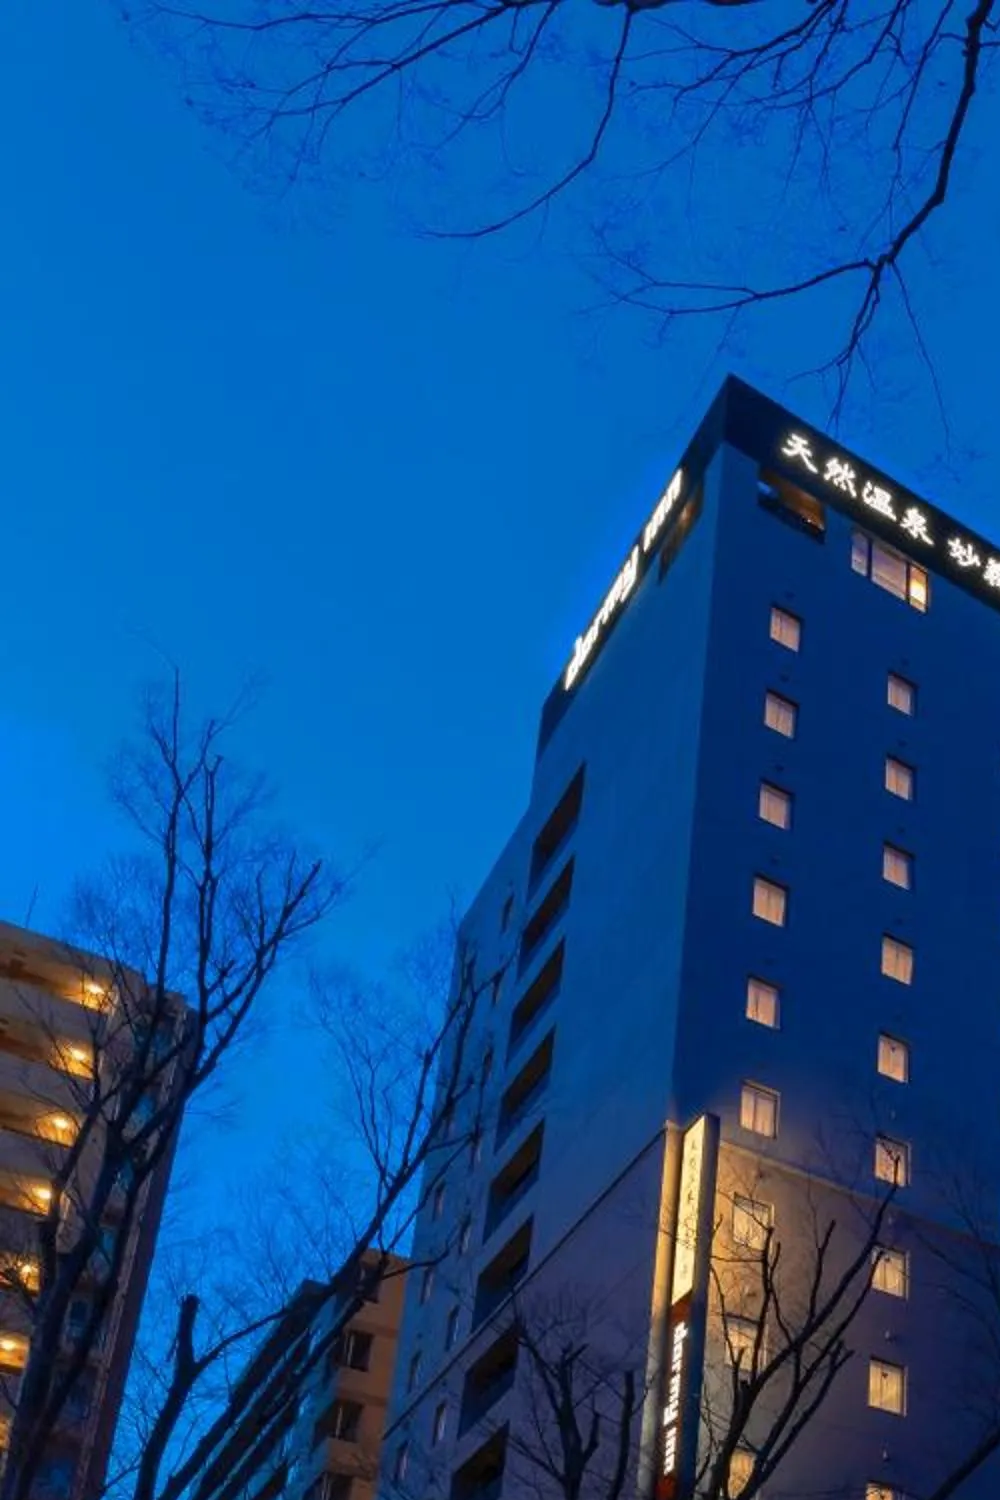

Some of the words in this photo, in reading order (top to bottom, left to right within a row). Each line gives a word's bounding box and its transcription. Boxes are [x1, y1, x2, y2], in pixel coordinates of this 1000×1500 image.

[782, 434, 933, 545] 天然温泉
[663, 1321, 688, 1426] dormy
[663, 1427, 677, 1475] inn
